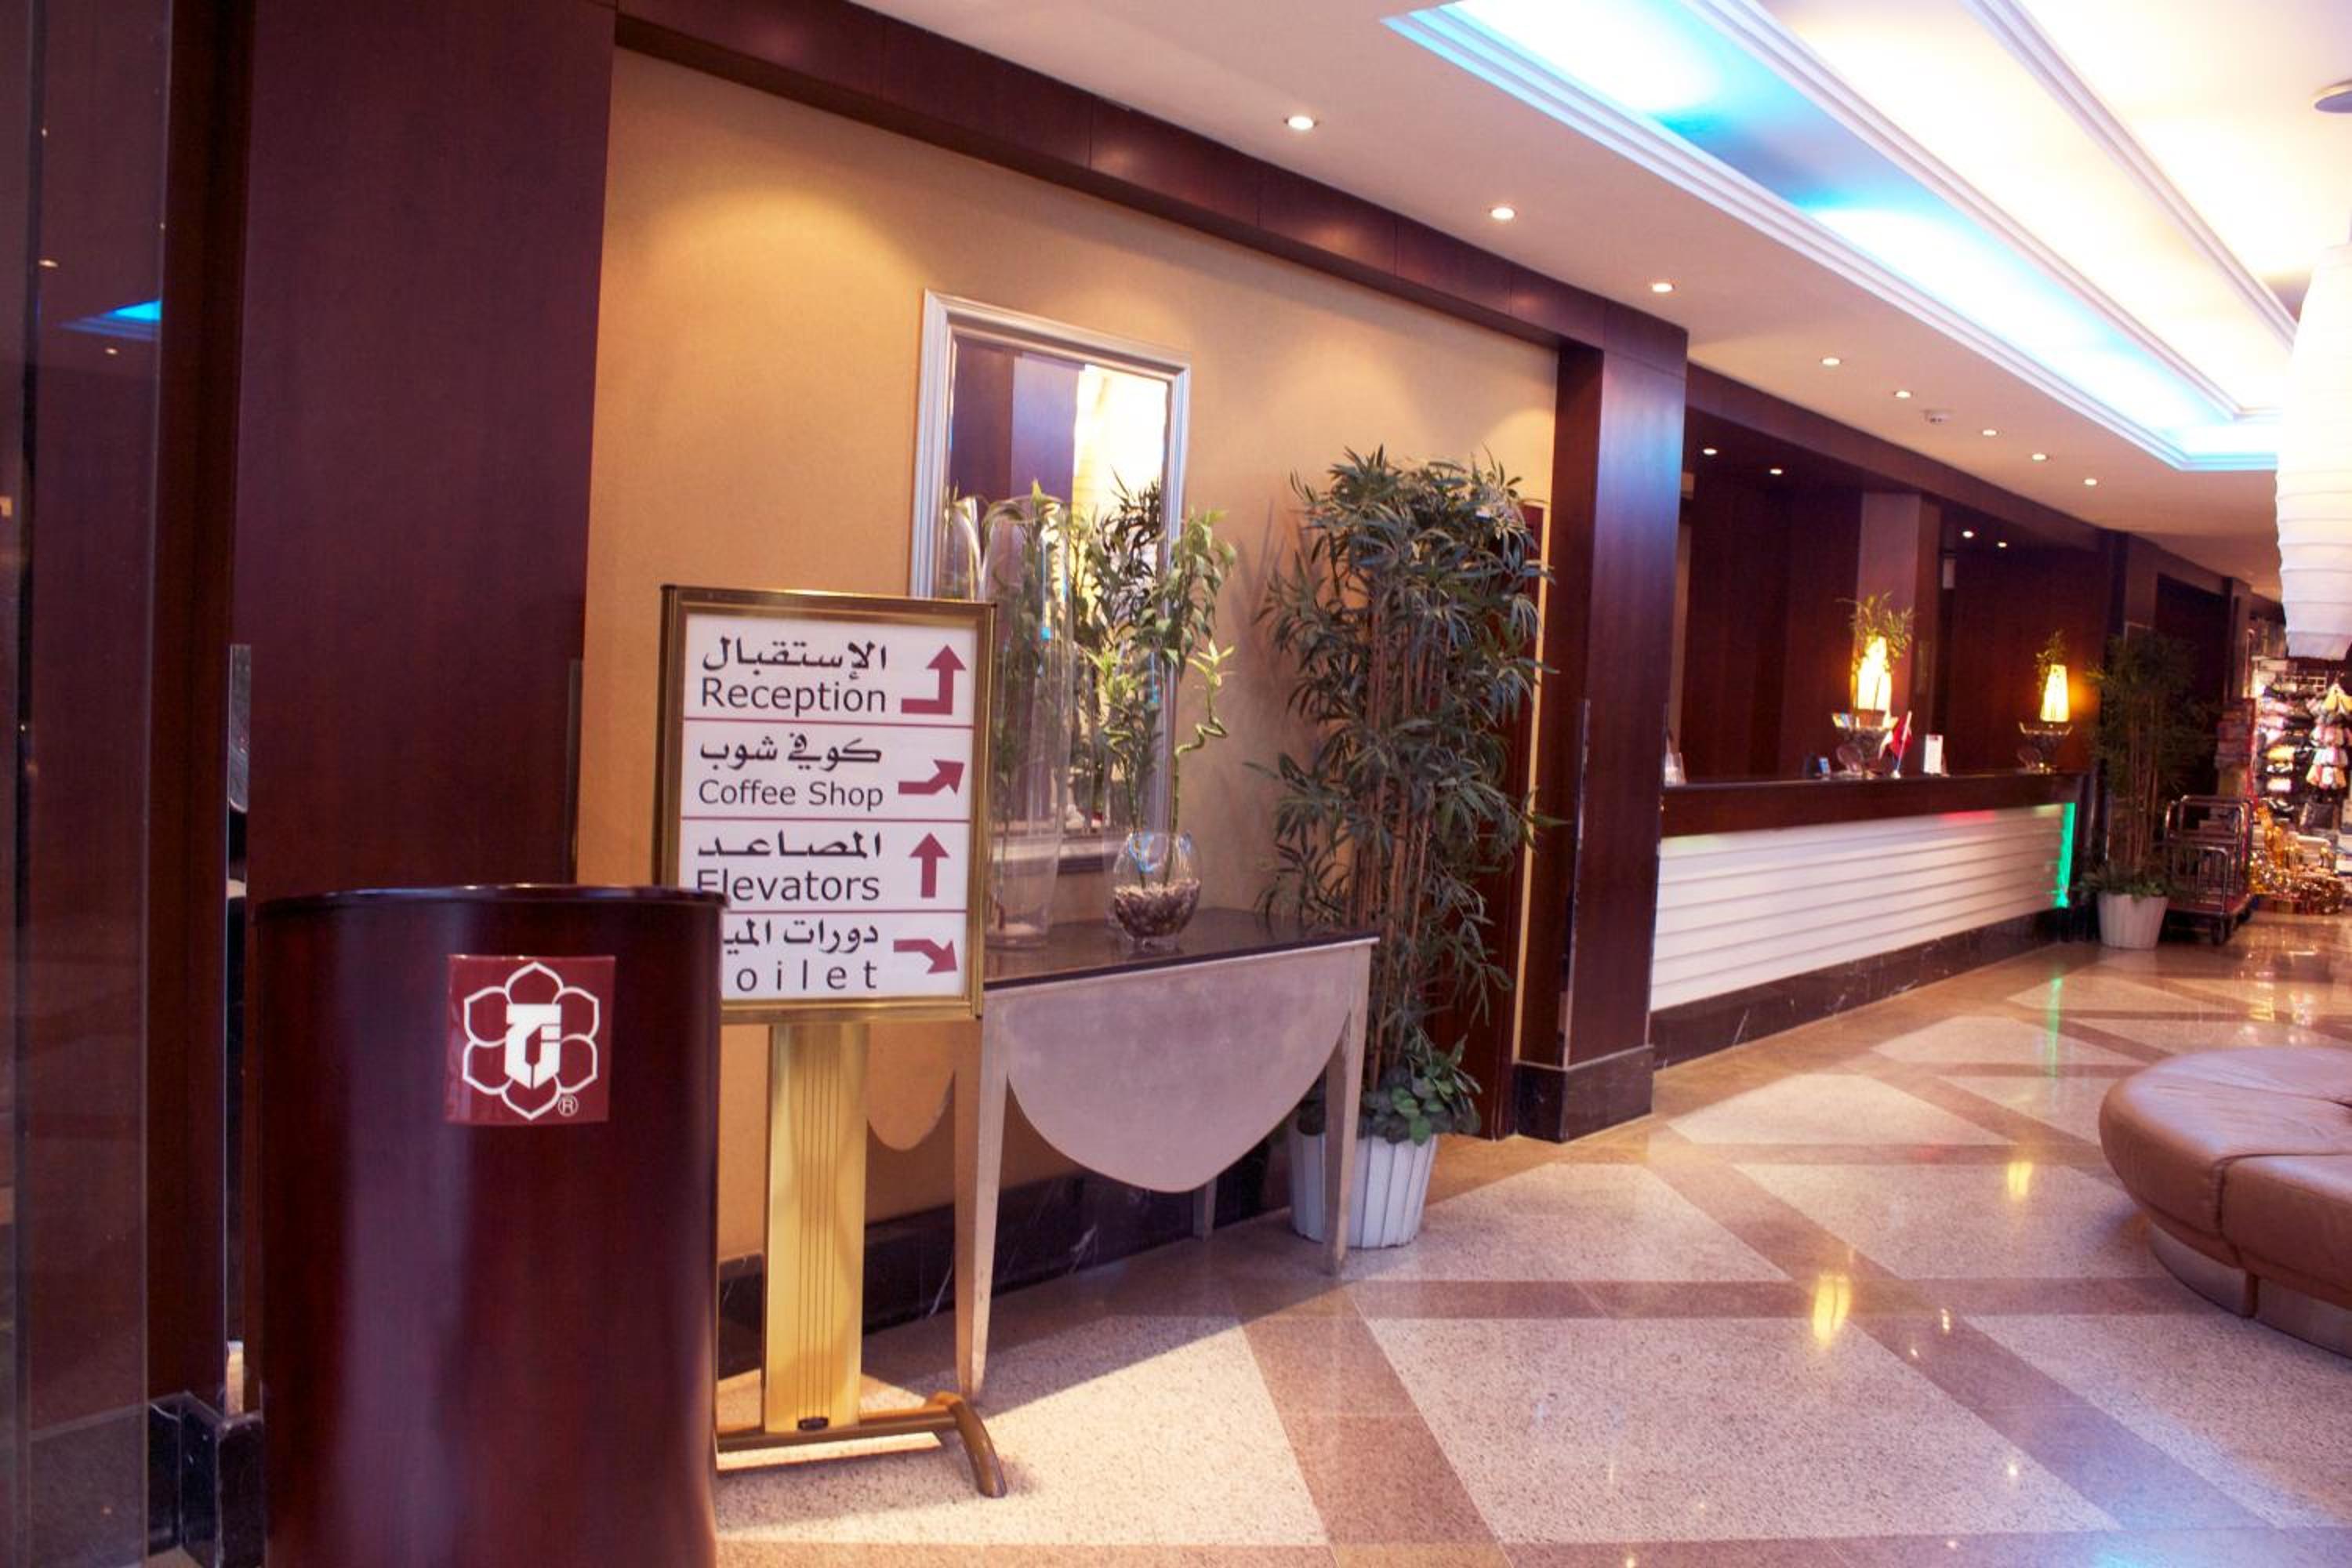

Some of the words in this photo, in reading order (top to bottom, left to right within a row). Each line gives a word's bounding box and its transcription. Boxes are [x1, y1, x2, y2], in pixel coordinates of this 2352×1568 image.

[702, 636, 887, 681] الإستقبال
[702, 677, 886, 717] Reception
[700, 736, 778, 770] شوب
[699, 779, 797, 808] Coffee
[808, 782, 884, 811] Shop
[697, 829, 882, 859] المصاعد
[696, 868, 880, 902] Elevators
[723, 918, 772, 955] المي
[783, 920, 880, 954] دورات
[735, 959, 878, 993] oilet
